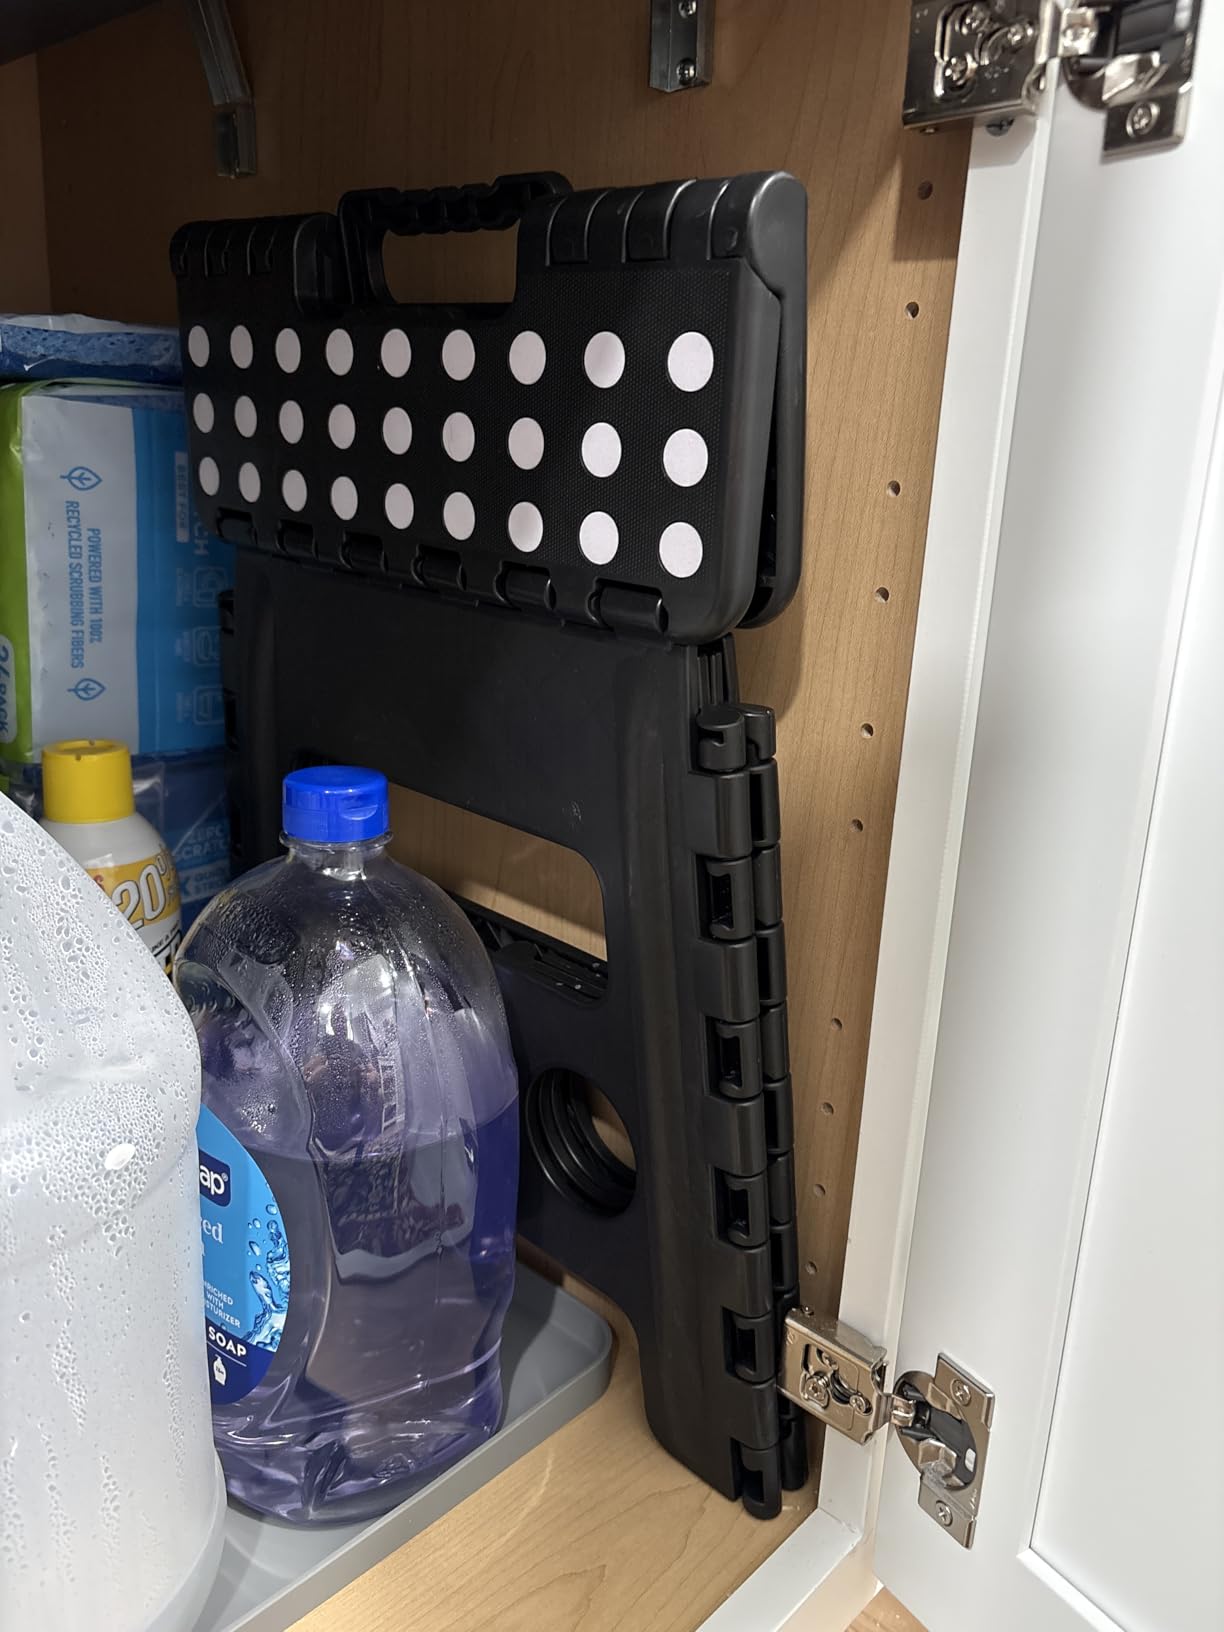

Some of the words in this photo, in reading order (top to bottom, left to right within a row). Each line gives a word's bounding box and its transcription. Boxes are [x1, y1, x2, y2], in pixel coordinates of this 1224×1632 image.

[65, 500, 82, 560] RECYCLED
[87, 528, 102, 583] POWERED
[68, 562, 84, 627] SCRUBBING
[89, 586, 103, 614] WITH
[89, 618, 103, 644] 100%
[70, 630, 85, 669] FIBERS
[200, 1217, 224, 1244] ed
[206, 1291, 224, 1310] WITH
[207, 1326, 247, 1357] SOAP
